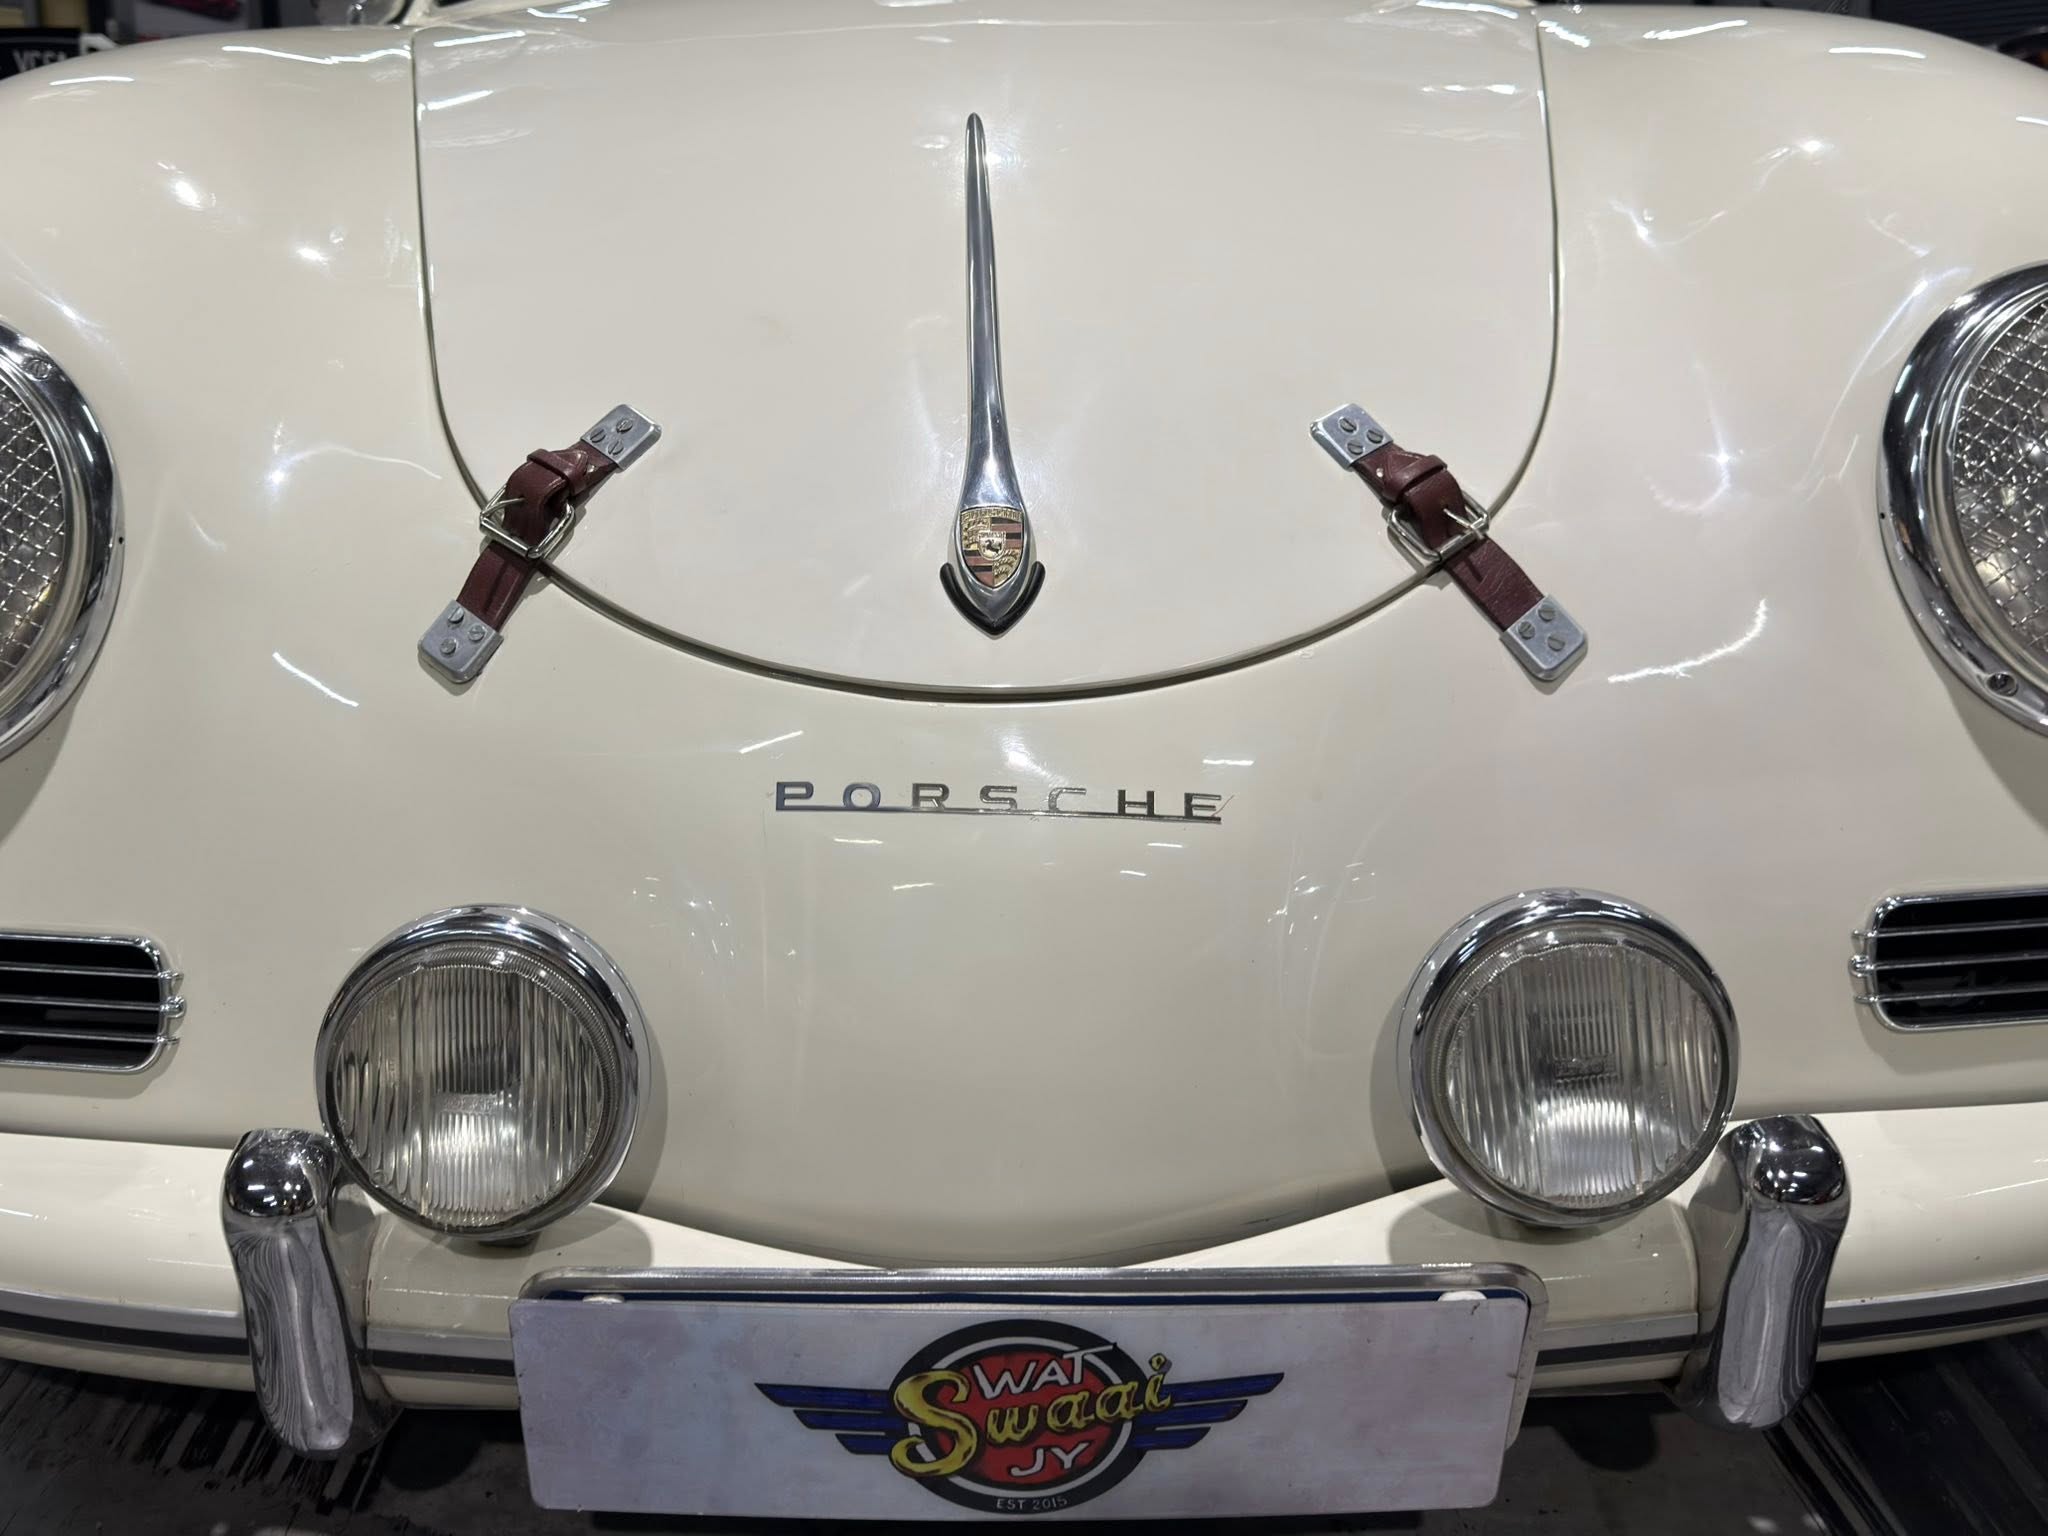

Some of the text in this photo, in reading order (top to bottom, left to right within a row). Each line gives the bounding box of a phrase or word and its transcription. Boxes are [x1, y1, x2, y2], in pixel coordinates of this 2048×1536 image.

[776, 781, 1222, 819] PORSCHE
[973, 1345, 1115, 1400] WAT
[889, 1353, 1172, 1477] Swaai
[1009, 1442, 1090, 1477] JY
[996, 1498, 1025, 1510] EST
